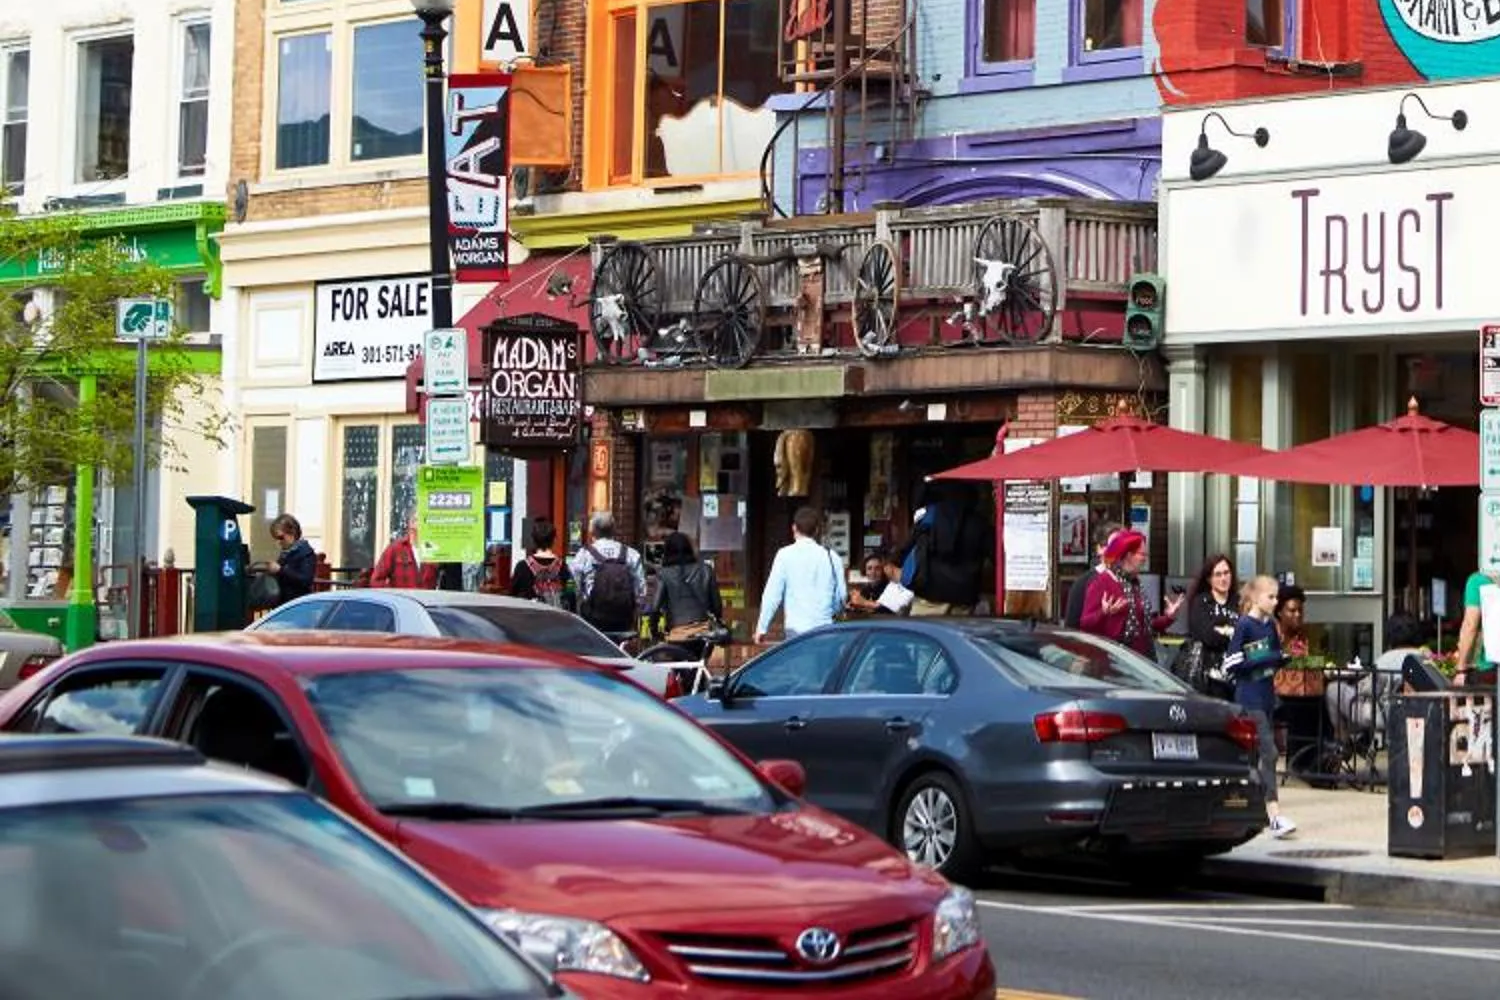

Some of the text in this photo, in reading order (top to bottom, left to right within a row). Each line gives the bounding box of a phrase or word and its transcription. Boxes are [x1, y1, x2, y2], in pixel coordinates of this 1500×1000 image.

[447, 91, 501, 228] EAT
[452, 249, 504, 265] MORGAN
[455, 236, 499, 252] ADAMS
[1291, 188, 1455, 317] TRYST
[331, 282, 429, 322] FOR SALE
[323, 341, 355, 357] AREA
[491, 370, 577, 398] ORGAN
